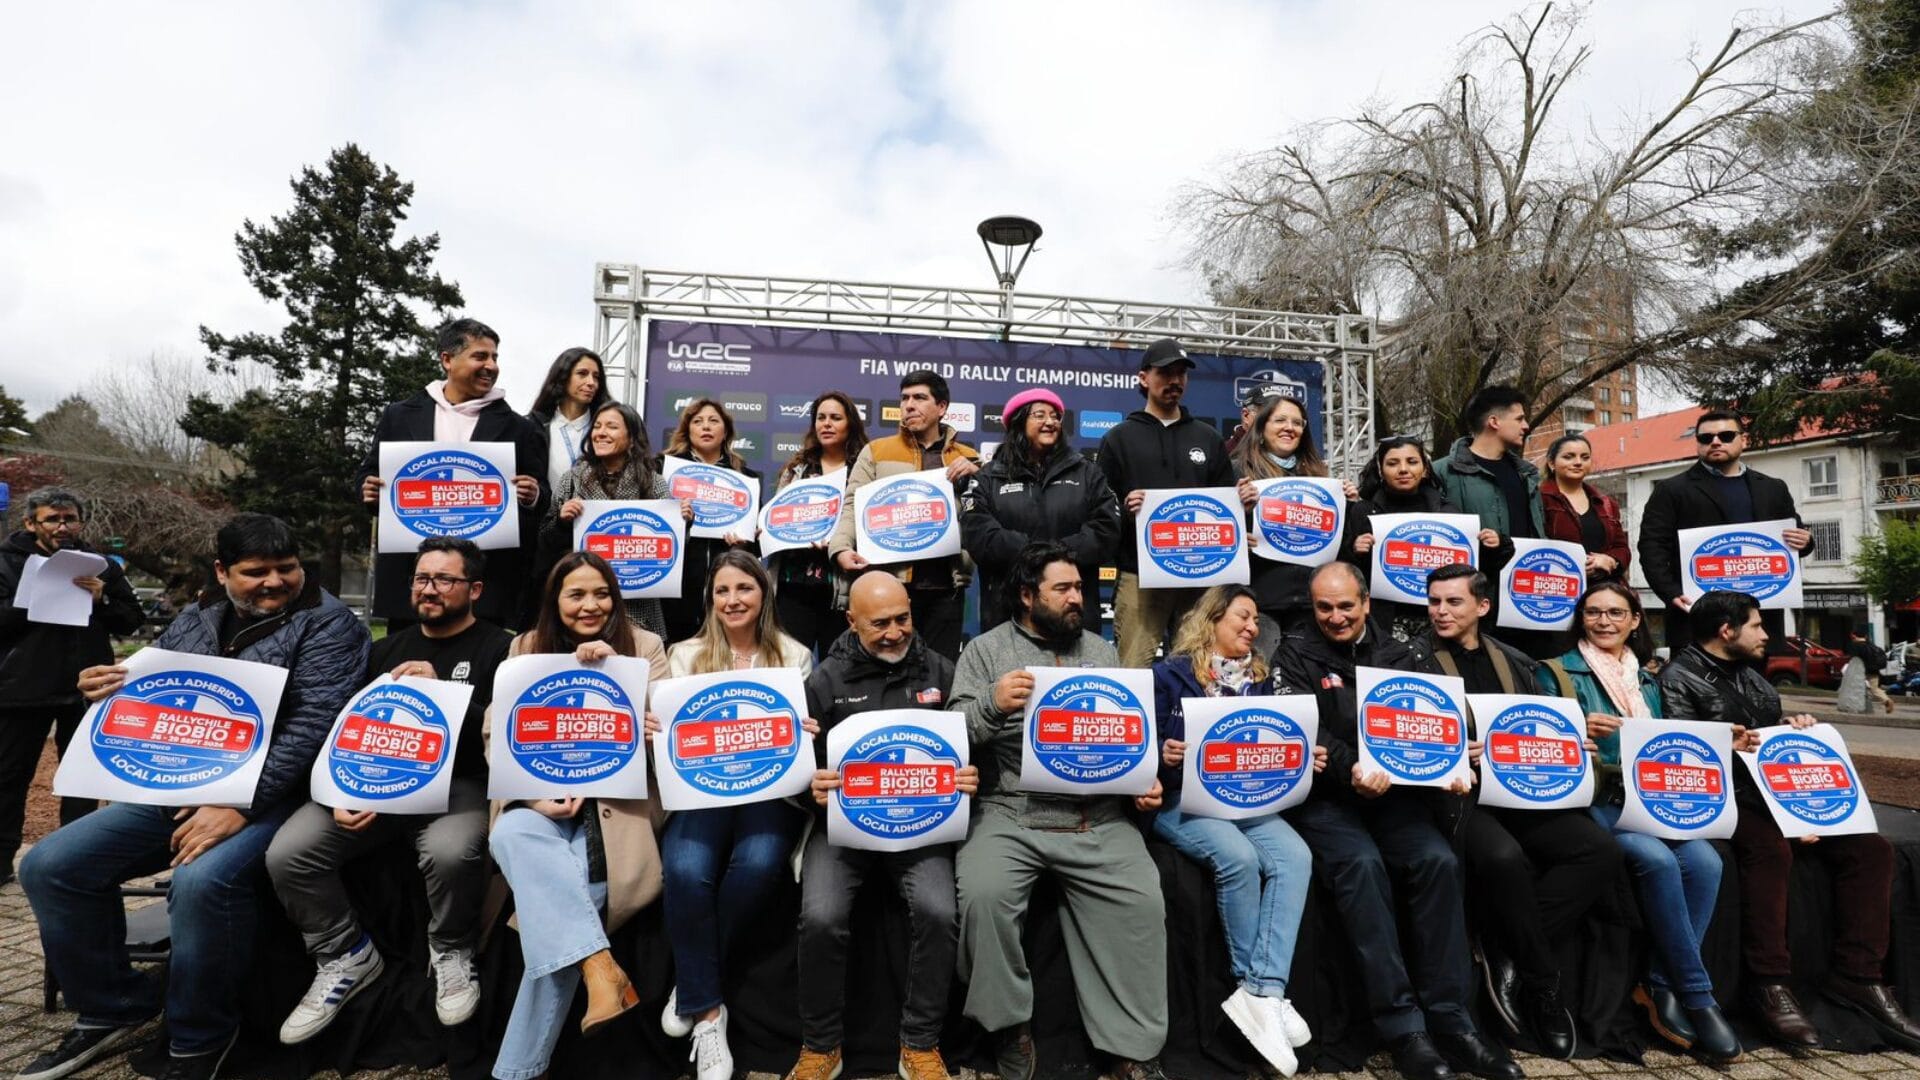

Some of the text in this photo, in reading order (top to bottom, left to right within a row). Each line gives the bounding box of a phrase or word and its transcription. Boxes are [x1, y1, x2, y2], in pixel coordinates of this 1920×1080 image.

[668, 341, 751, 361] WRC
[861, 359, 1140, 389] FIA WORLD RALLY CHAMPIONSHIP
[725, 402, 761, 411] arauco
[942, 413, 970, 422] OPEC
[408, 456, 487, 473] LOCAL ADHERIDO
[1268, 484, 1291, 494] LOCAL
[1159, 500, 1223, 515] LOCAL ADHERIDO
[413, 518, 491, 536] LOCAL ADHERIDO
[595, 514, 620, 528] LOCAL
[1396, 524, 1460, 540] LOCAL ADHERIDO
[1269, 533, 1323, 551] LOCAL ADHERIDO
[1703, 536, 1772, 551] LOCAL ADHERIDO
[1163, 558, 1226, 574] LOCAL ADHERIDO
[624, 571, 662, 586] ADHERIDO
[1395, 576, 1419, 591] LOCAL
[137, 678, 245, 706] LOCAL ADHERIDO
[532, 677, 620, 698] LOCAL ADHERIDO
[1051, 682, 1128, 701] LOCAL ADHERIDO
[1375, 683, 1445, 704] LOCAL ADHERIDO
[359, 691, 434, 717] LOCAL ADHERIDO
[686, 688, 775, 714] LOCAL ADHERIDO
[158, 712, 233, 729] RALLYCHILE
[556, 713, 616, 721] RALLYCHILE
[1215, 715, 1292, 734] LOCAL ADHERIDO
[1396, 714, 1443, 725] RALLYCHILE
[1499, 710, 1565, 728] LOCAL ADHERIDO
[153, 720, 229, 742] BIOBÍO
[366, 725, 424, 740] RALLYCHILE
[556, 721, 615, 733] BIOBÍO
[713, 720, 773, 734] RALLYCHILE
[1072, 724, 1126, 736] BIOBÍO
[1396, 722, 1443, 736] BIOBÍO
[362, 734, 421, 752] BIOBÍO
[714, 729, 773, 747] BIOBÍO
[856, 732, 942, 754] LOCAL ADHERIDO
[1236, 746, 1287, 755] RALLYCHILE
[1646, 739, 1710, 757] LOCAL ADHERIDO
[1763, 741, 1784, 757] LOCAL
[530, 757, 620, 778] LOCAL ADHERIDO
[1050, 758, 1130, 778] LOCAL ADHERIDO
[1236, 753, 1285, 765] BIOBÍO
[1380, 752, 1450, 775] LOCAL ADHERIDO
[110, 754, 223, 784] LOCAL ADHERIDO
[694, 763, 782, 791] LOCAL ADHERIDO
[880, 768, 937, 776] RALLYCHILE
[335, 765, 418, 793] LOCAL ADHERIDO
[880, 775, 937, 789] BIOBÍO
[1507, 777, 1574, 797] LOCAL ADHERIDO
[1216, 782, 1288, 803] LOCAL ADHERIDO
[1653, 805, 1715, 824] LOCAL ADHERIDO
[1790, 801, 1851, 821] LOCAL ADHERIDO
[858, 811, 943, 833] LOCAL ADHERIDO
